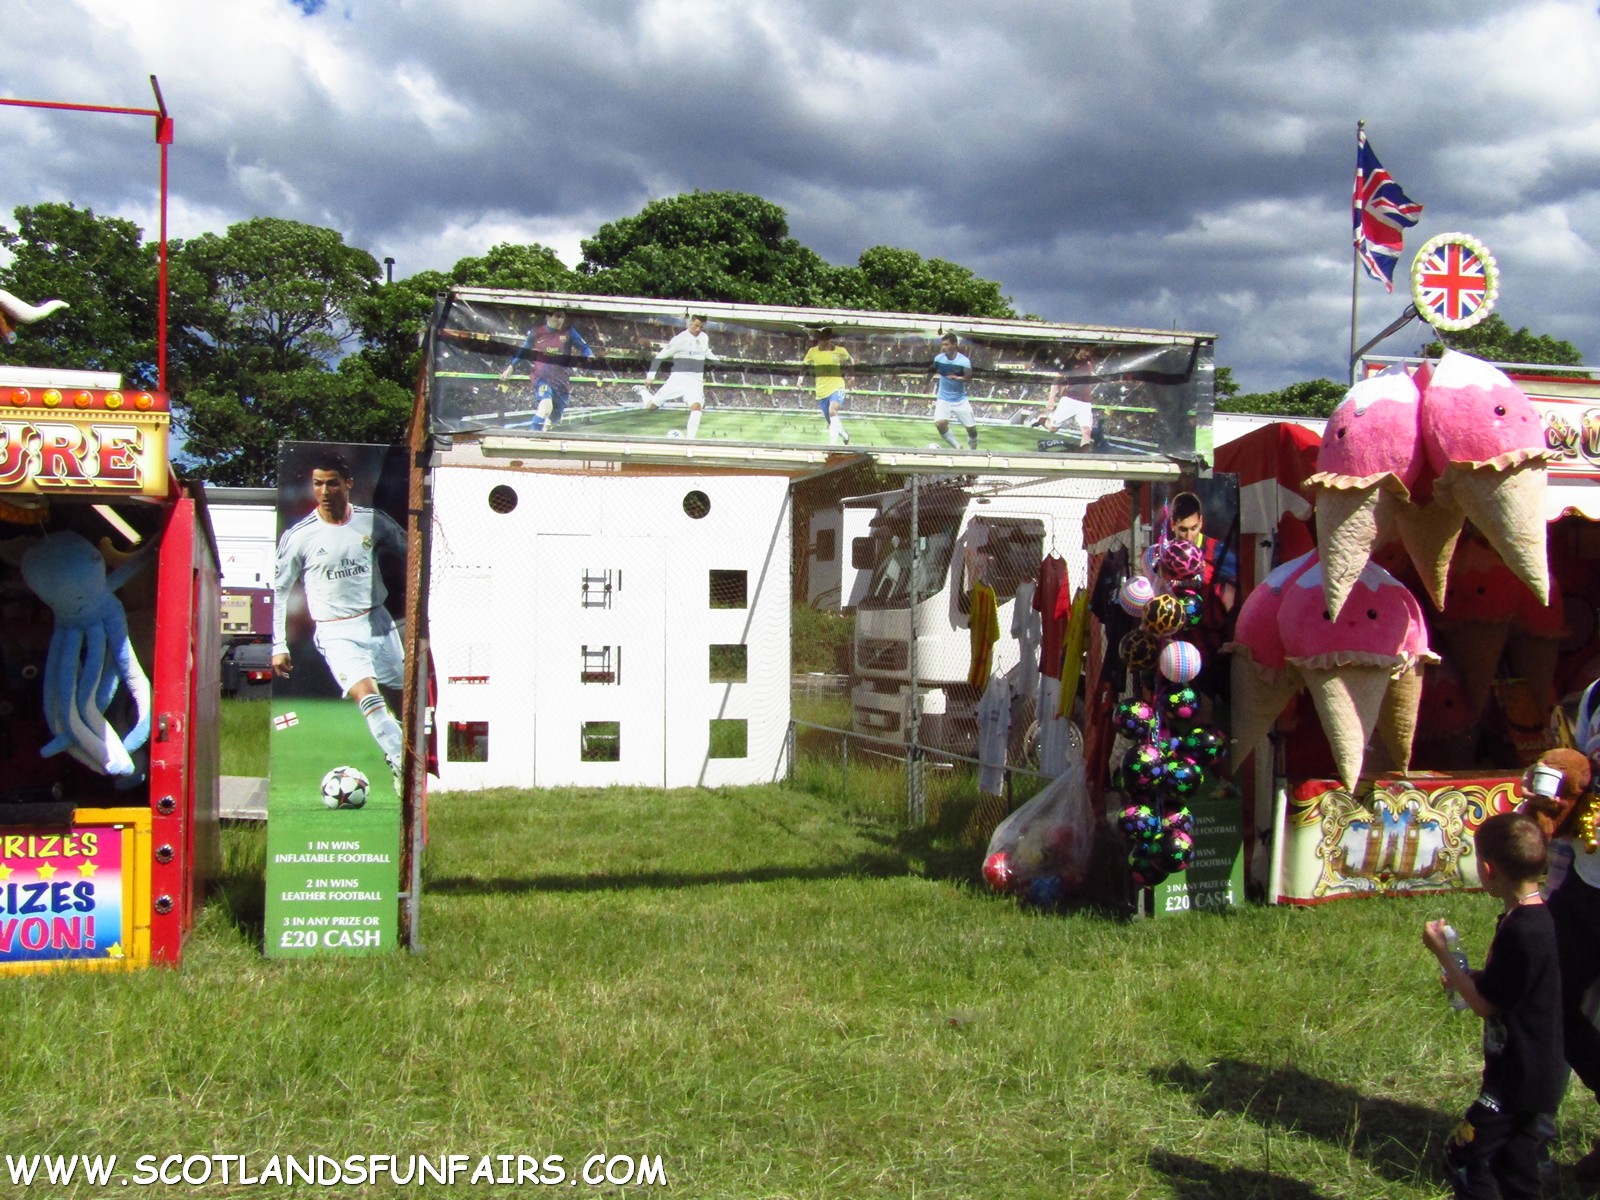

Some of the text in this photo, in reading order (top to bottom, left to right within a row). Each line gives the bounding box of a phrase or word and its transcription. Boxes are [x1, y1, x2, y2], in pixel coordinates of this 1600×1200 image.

[327, 563, 369, 580] Emirates
[1196, 816, 1215, 824] WINS
[1201, 825, 1237, 835] FOOTBALL
[0, 832, 98, 858] RIZES
[308, 841, 360, 850] 1 IN WINS
[1197, 848, 1216, 857] WINS
[275, 854, 390, 863] INFLATABLE FOOTBALL
[1196, 858, 1232, 867] FOOTBALL
[306, 879, 359, 888] 2 IN WINS
[1166, 879, 1232, 893] 3 IN ANY PRIZE OR
[0, 881, 96, 915] IZES
[282, 891, 381, 901] LEATHER FOOTBALL
[1165, 890, 1234, 912] £20 CASH
[283, 917, 379, 926] 3 IN ANY PRIZE OR
[280, 930, 381, 948] £20 CASH
